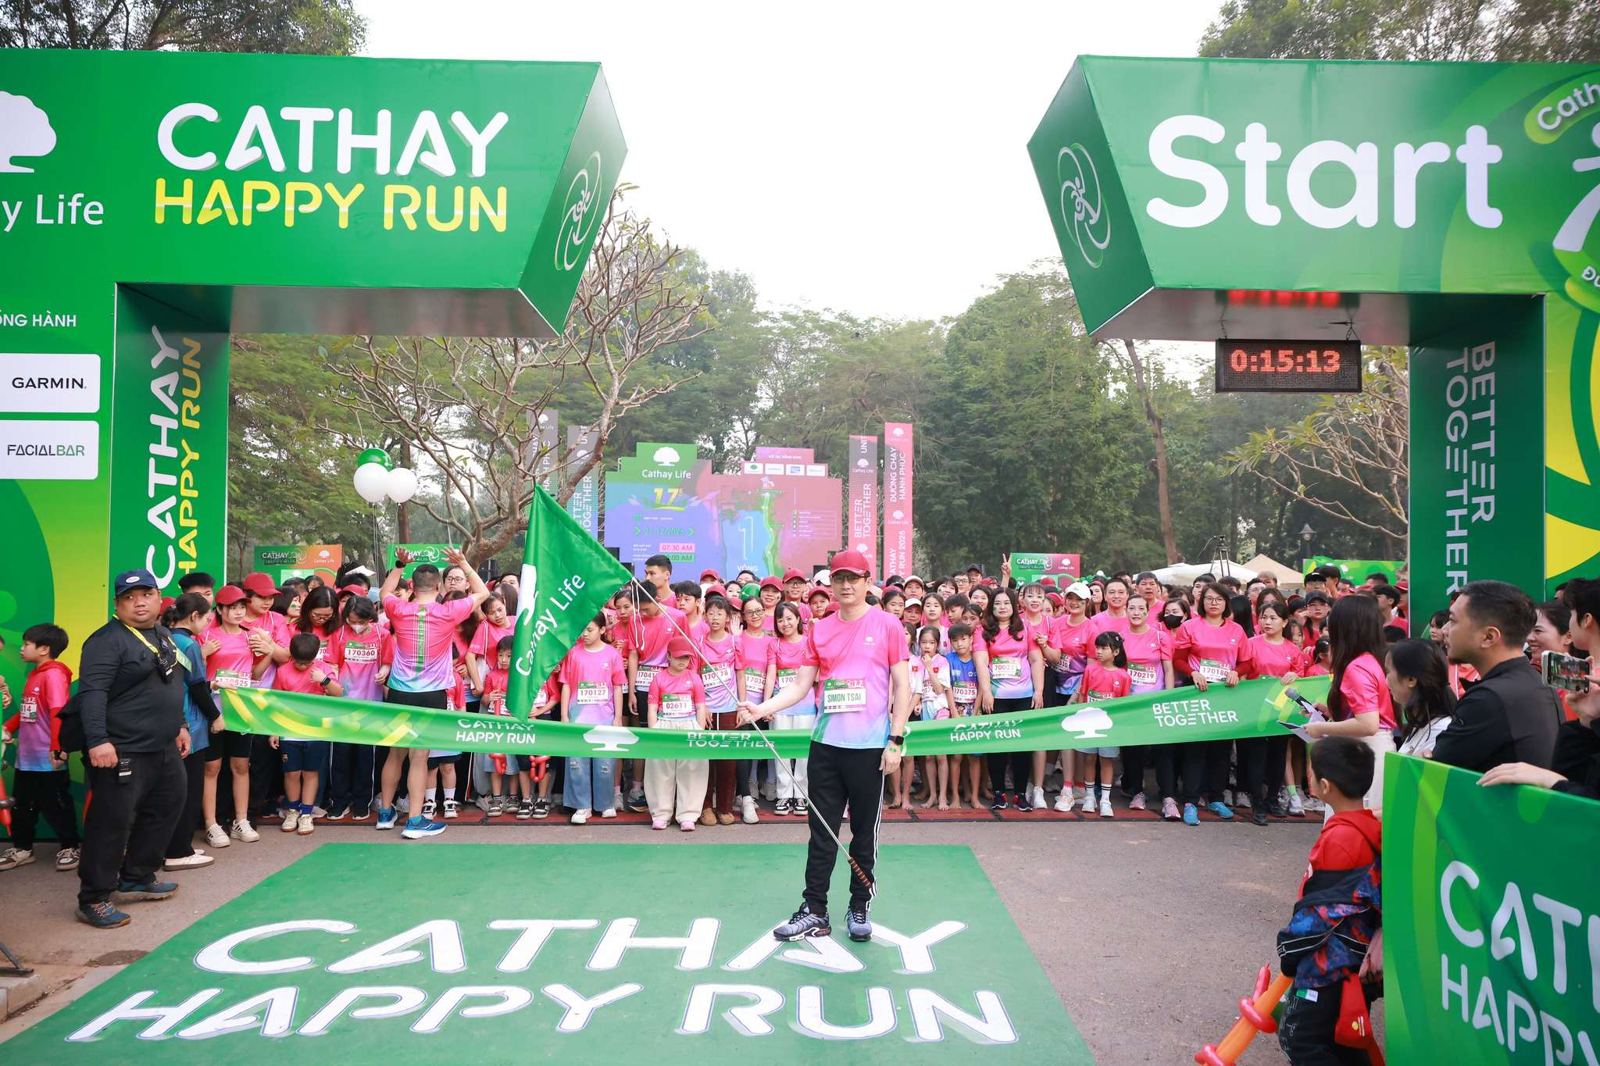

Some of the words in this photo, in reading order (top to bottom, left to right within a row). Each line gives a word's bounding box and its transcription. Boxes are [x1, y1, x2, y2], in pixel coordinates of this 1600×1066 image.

[157, 102, 509, 178] CATHAY
[1146, 114, 1503, 229] Start
[36, 193, 104, 225] Life
[154, 177, 364, 230] HAPPY
[383, 184, 508, 233] RUN
[0, 307, 28, 327] NG
[32, 309, 77, 327] HÀNH
[1230, 349, 1341, 373] 0:15:13
[180, 337, 201, 429] RUN
[1471, 341, 1496, 523] BETTER
[7, 445, 85, 456] FACIALBAR
[145, 325, 180, 589] CATHAY
[642, 469, 673, 479] Cathay
[675, 470, 692, 479] Life
[1446, 347, 1469, 596] TOGETHER
[889, 548, 897, 577] ATHAY
[549, 574, 586, 611] Life
[1152, 699, 1212, 716] BETTER
[1154, 710, 1239, 728] TOGETHER
[455, 731, 504, 743] HAPPY
[507, 732, 536, 745] RUN
[950, 730, 992, 742] HAPPY
[994, 728, 1021, 739] RUN
[194, 919, 966, 976] CATHAY
[65, 984, 644, 1041] HAPPY
[676, 984, 1019, 1045] RUN
